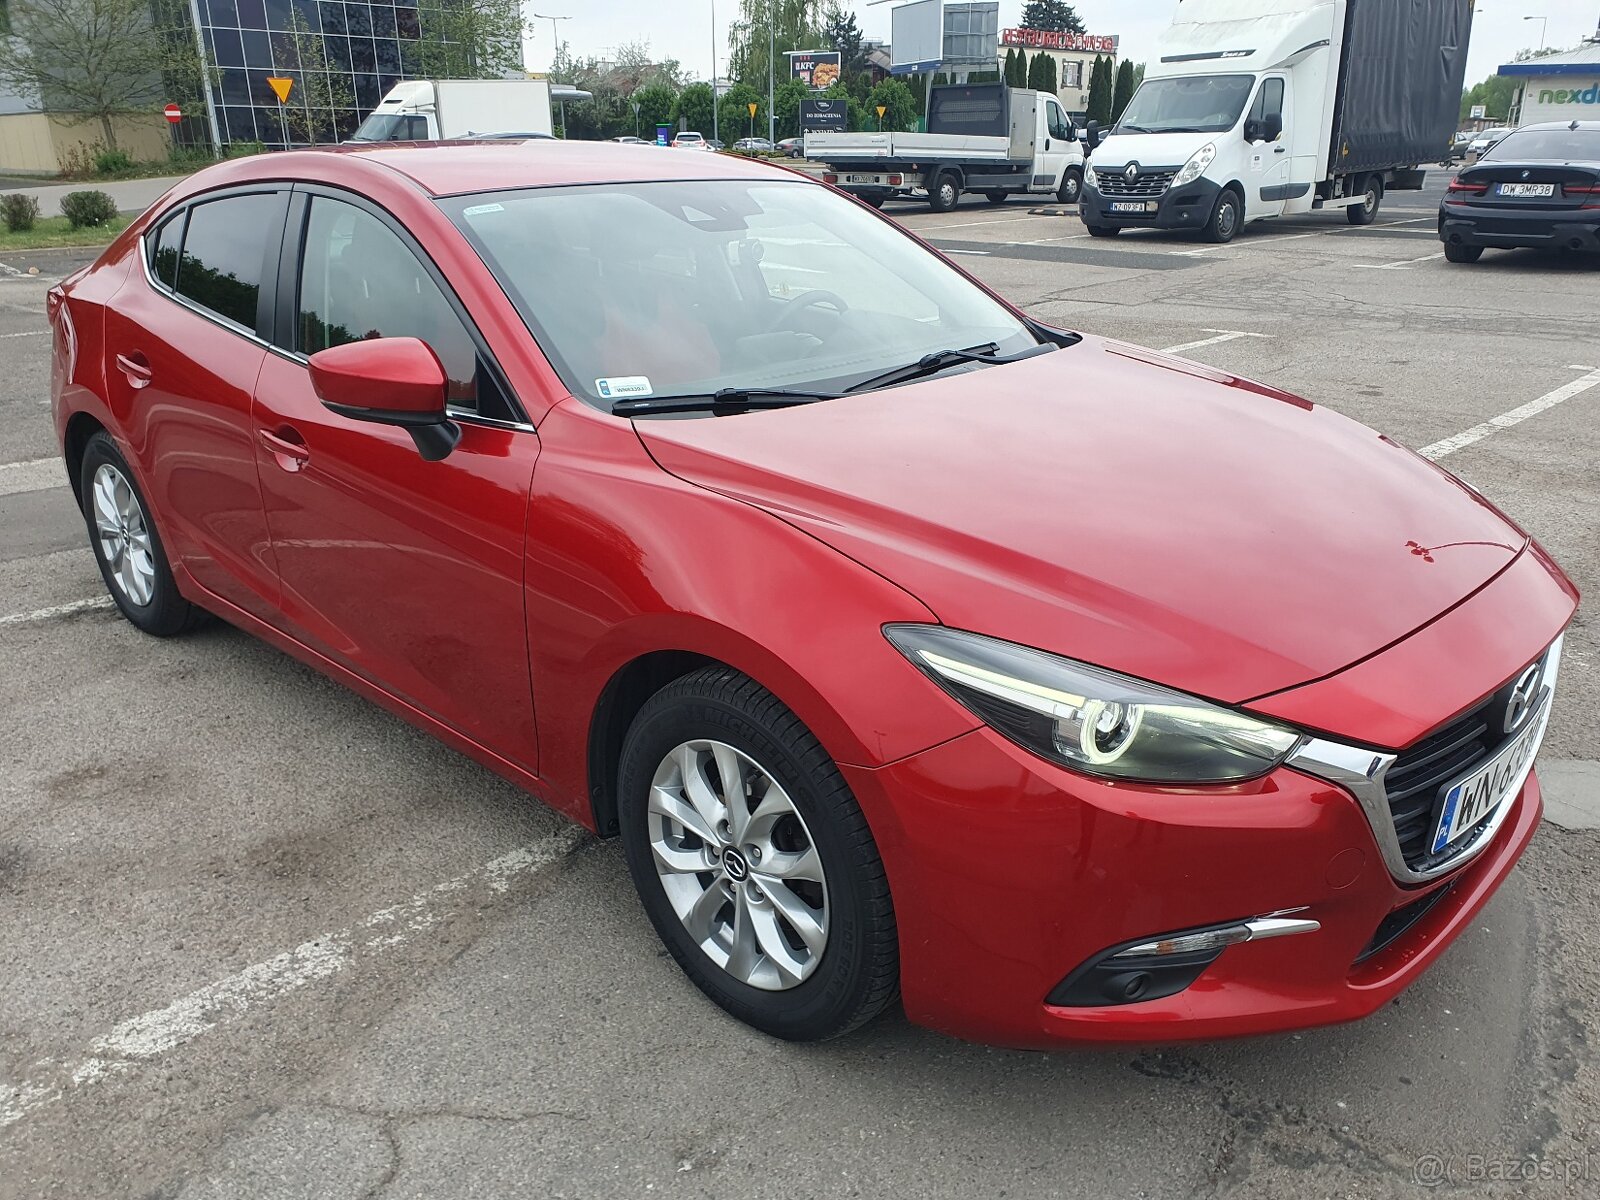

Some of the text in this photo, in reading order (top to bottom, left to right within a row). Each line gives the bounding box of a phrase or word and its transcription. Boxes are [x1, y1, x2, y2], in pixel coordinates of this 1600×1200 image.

[800, 61, 815, 70] KFC
[1538, 82, 1600, 105] nexd
[1503, 184, 1552, 195] DW 3MR38
[1456, 763, 1499, 832] WN
